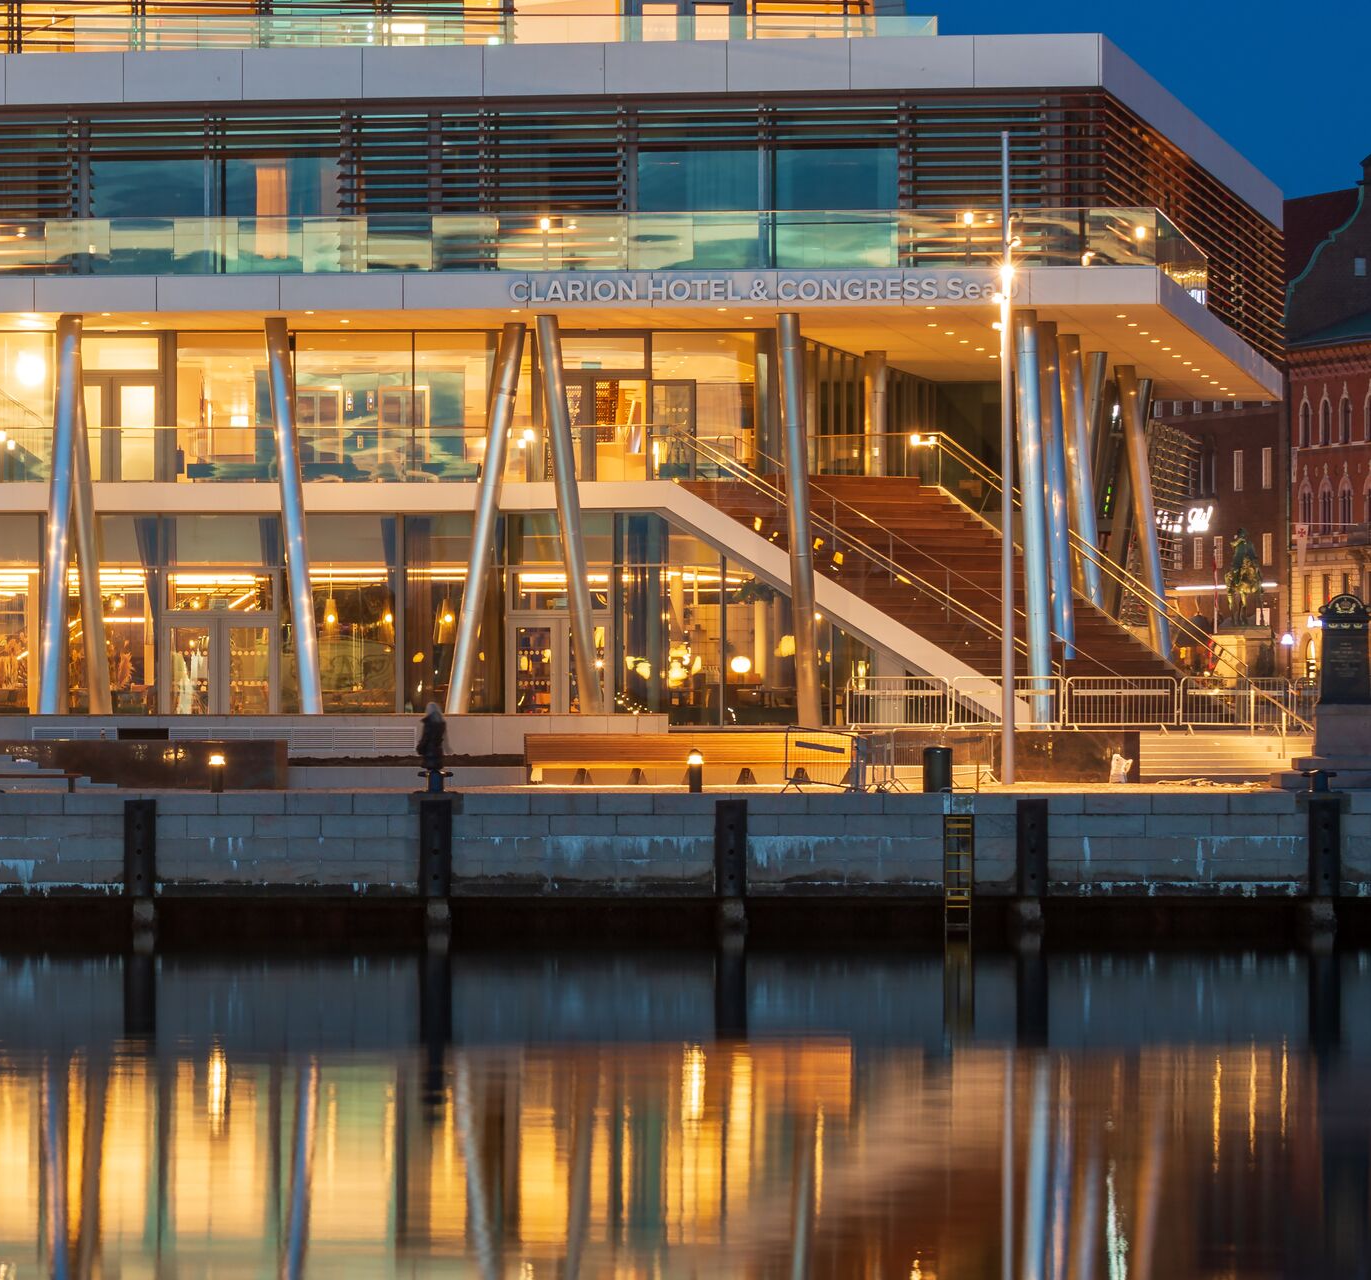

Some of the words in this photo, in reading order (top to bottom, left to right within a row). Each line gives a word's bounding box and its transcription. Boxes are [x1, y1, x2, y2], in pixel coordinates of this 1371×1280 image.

[509, 279, 637, 302] CLARION
[648, 279, 741, 301] HOTEL
[749, 279, 768, 301] &
[777, 278, 938, 301] CONGRESS
